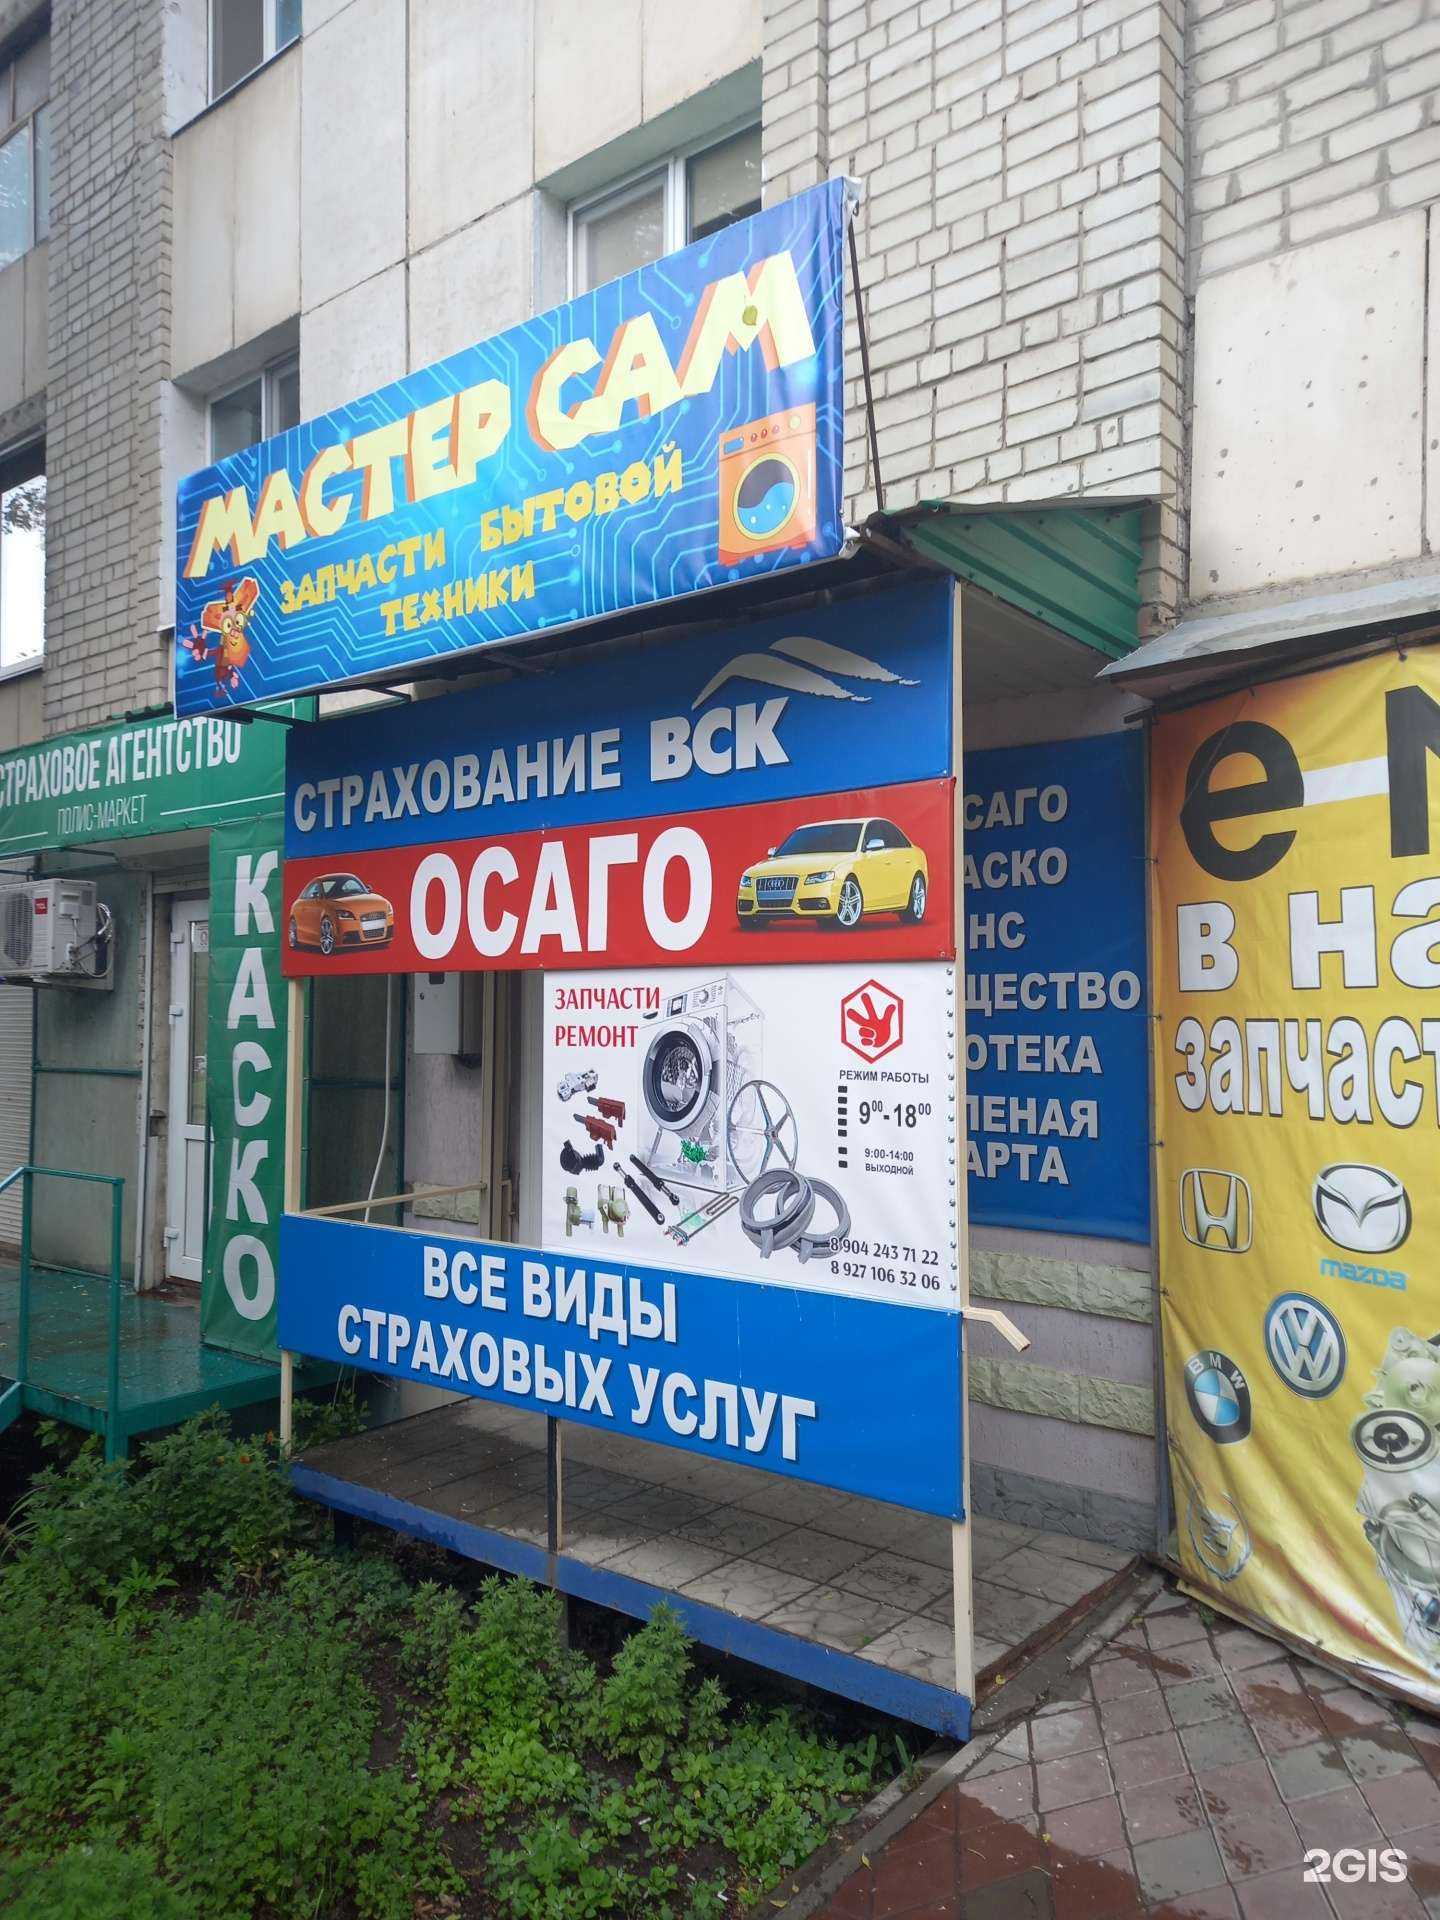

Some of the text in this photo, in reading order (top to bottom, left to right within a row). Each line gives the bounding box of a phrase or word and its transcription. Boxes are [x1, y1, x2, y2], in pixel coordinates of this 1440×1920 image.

[183, 250, 817, 578] МАСТЕР САМ
[279, 441, 683, 613] ЗАПЧАСТИ БЫТОВОЙ
[380, 560, 535, 636] ТЕХНИКИ
[0, 718, 242, 809] СТРАХОВОЕ АГЕНТСТВО
[294, 697, 789, 833] СТРАХОВАНИЕ ВСК
[57, 794, 147, 835] ПОЛИС-МАРКЕТ
[409, 826, 713, 960] ОСАГО
[1177, 901, 1239, 992] в
[555, 986, 660, 1010] ЗАПЧАСТИ
[555, 1025, 638, 1048] РЕМОНТ
[966, 1034, 1102, 1074] ОТЕКА
[223, 850, 279, 1321] КАСКО
[839, 1070, 929, 1084] РЕЖИМ РАБОТЫ
[864, 1148, 914, 1162] 9:00-14:00
[865, 1163, 914, 1175] ВЫХОДНОЙ
[830, 1237, 939, 1266] 8 904 243 71 22
[830, 1260, 940, 1290] 8 927 106 32 06
[423, 1246, 677, 1346] ВСЕ ВИДЫ
[337, 1304, 816, 1460] СТРАХОВЫХ УСЛУГ
[1187, 1352, 1247, 1392] BMW
